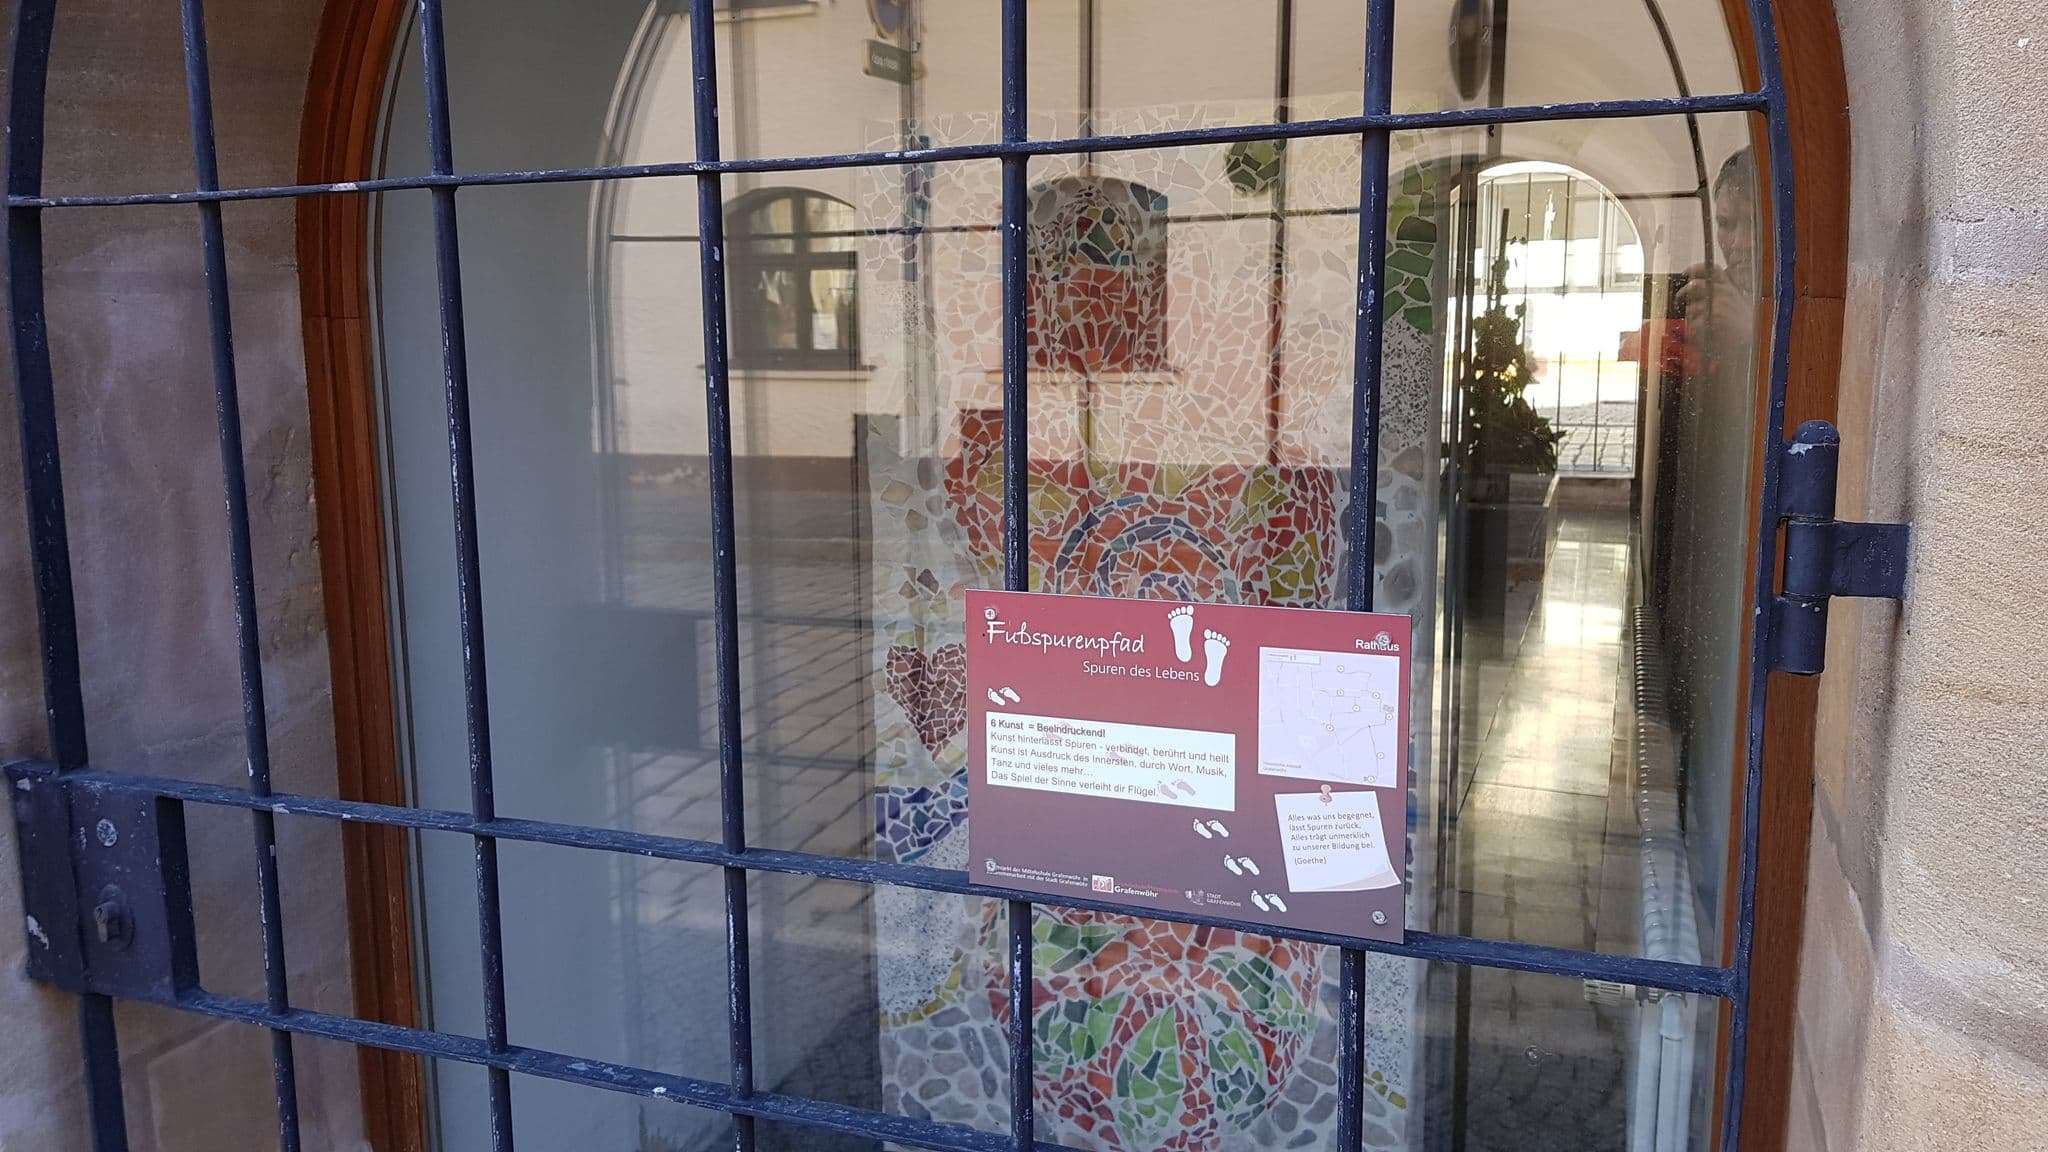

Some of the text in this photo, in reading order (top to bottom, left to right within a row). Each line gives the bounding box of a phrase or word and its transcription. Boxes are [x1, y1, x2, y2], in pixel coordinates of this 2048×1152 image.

[987, 621, 1145, 658] Fußspurenpfad
[1355, 639, 1400, 652] Rathaus
[1083, 661, 1200, 681] Spuren des Lebens
[990, 719, 997, 728] 6
[998, 719, 1024, 730] Kunst
[1036, 723, 1106, 738] Beeindruckend!
[990, 731, 1016, 742] Kunst
[1065, 738, 1097, 750] Spuren
[1153, 747, 1187, 760] berührt
[1188, 752, 1207, 761] und
[1209, 753, 1229, 764] heilt
[990, 744, 1016, 755] Kunst
[1017, 748, 1028, 757] ist
[1030, 749, 1071, 761] Ausdruck
[1073, 753, 1090, 763] des
[1139, 760, 1166, 771] durch
[1168, 762, 1194, 774] Wort,
[1196, 765, 1227, 778] Musik,
[991, 757, 1013, 768] Tanz
[1014, 761, 1031, 770] und
[1033, 763, 1059, 773] vieles
[991, 770, 1008, 780] Das
[1010, 772, 1033, 783] Spiel
[1034, 775, 1049, 785] der
[1051, 777, 1077, 788] Sinne
[1079, 780, 1112, 792] verleiht
[1113, 783, 1125, 793] dir
[1306, 823, 1333, 831] Spuren
[1291, 833, 1308, 841] Alles
[1328, 831, 1370, 840] unmerklich
[1302, 843, 1330, 851] unserer
[1331, 842, 1360, 850] Bildung
[1294, 856, 1327, 866] (Goethe)
[1114, 884, 1159, 899] Grafenwöhr
